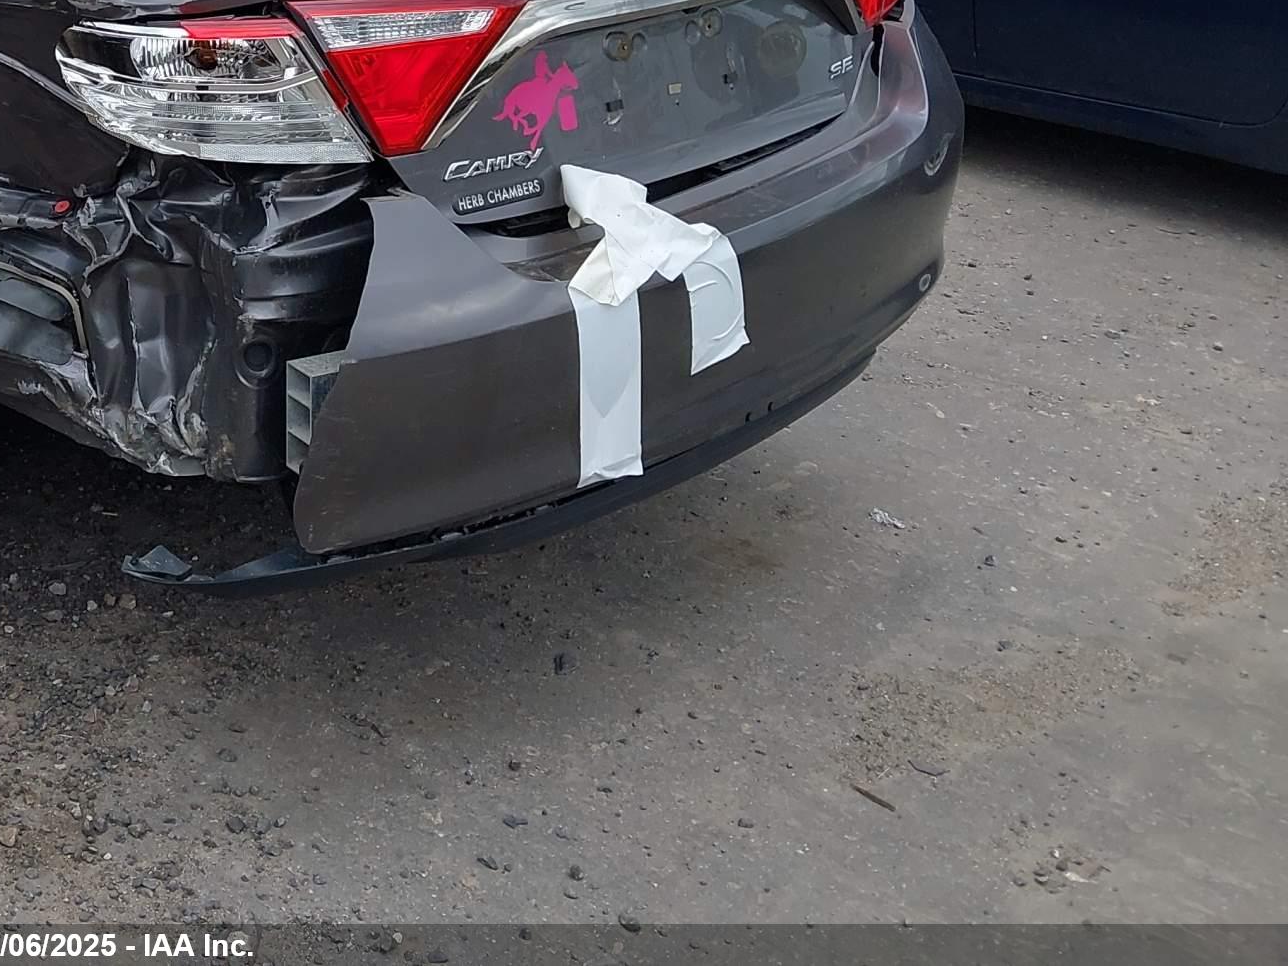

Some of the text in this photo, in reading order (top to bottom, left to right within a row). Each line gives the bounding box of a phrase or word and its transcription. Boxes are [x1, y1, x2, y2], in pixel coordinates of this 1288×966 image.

[830, 55, 854, 80] SE
[443, 147, 544, 181] CAMRY
[457, 179, 541, 211] HERB CHAMBERS
